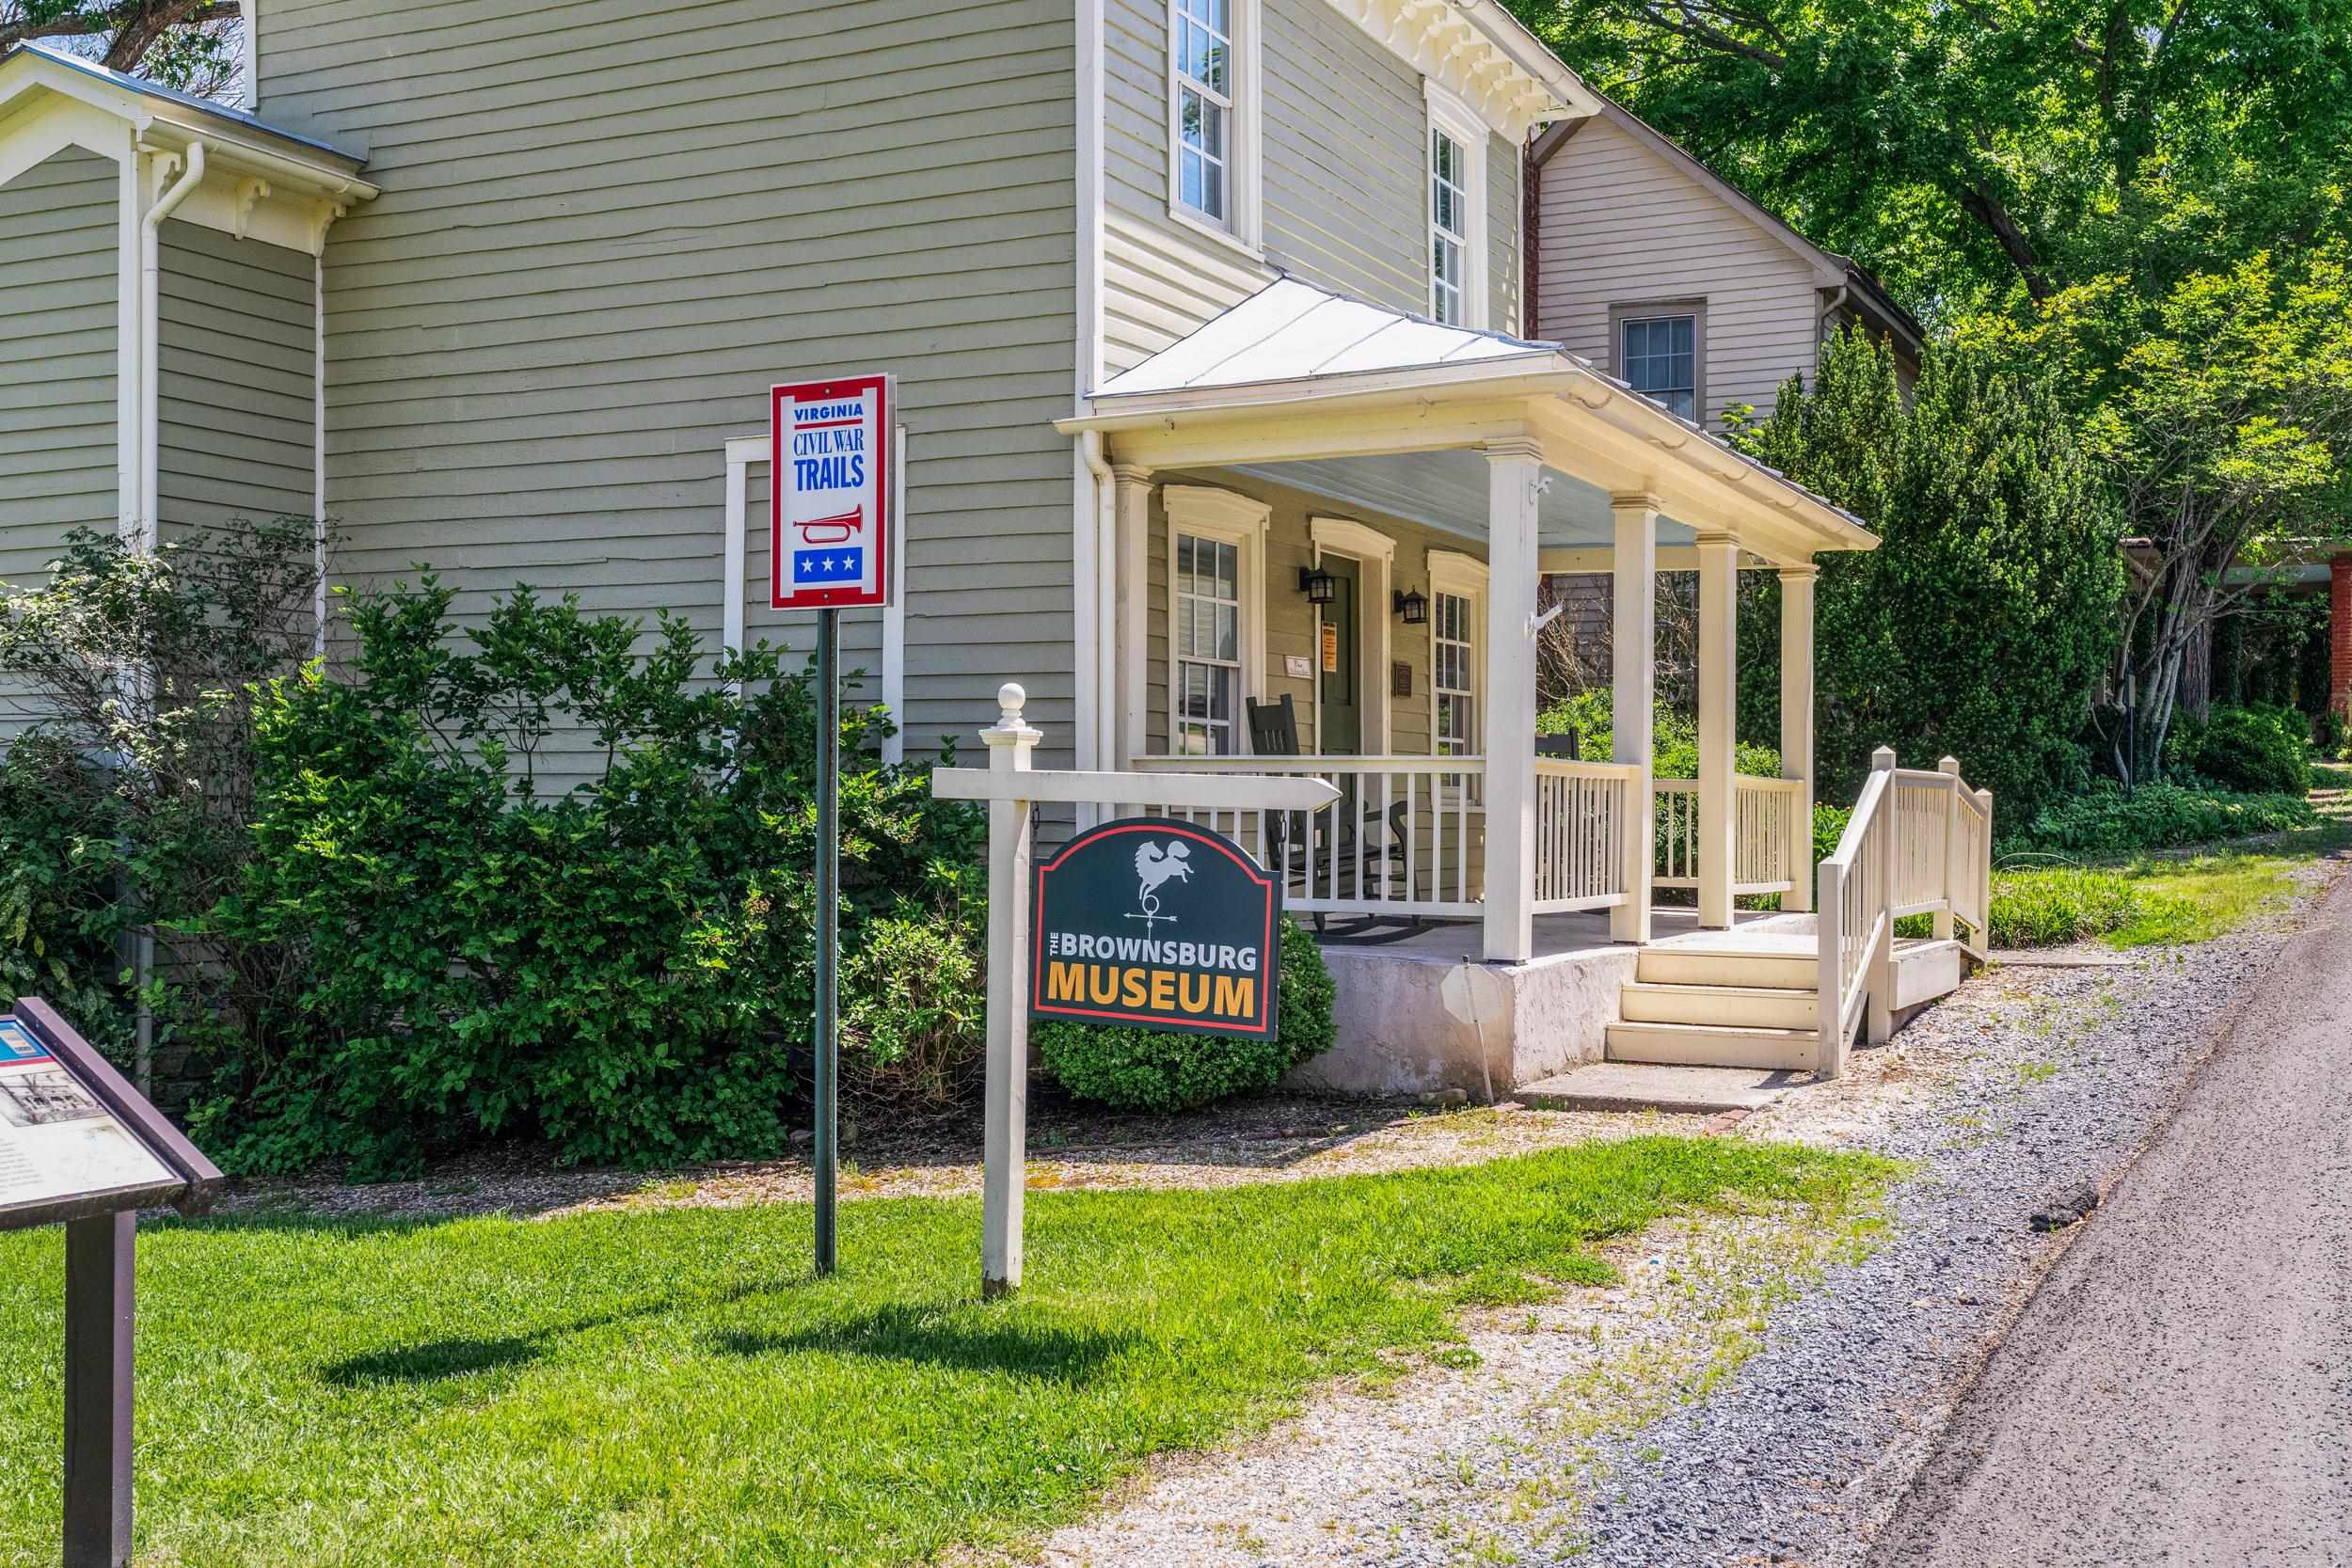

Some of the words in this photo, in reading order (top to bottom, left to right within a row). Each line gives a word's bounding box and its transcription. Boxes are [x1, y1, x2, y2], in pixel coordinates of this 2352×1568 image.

[794, 403, 864, 421] VIRGINIA
[793, 431, 833, 456] CIVIL
[834, 428, 865, 452] WAR
[793, 454, 865, 491] TRAILS
[1049, 932, 1059, 957] THE
[1060, 932, 1257, 971] BROWNSBURG
[1047, 961, 1254, 1018] MUSEUM
